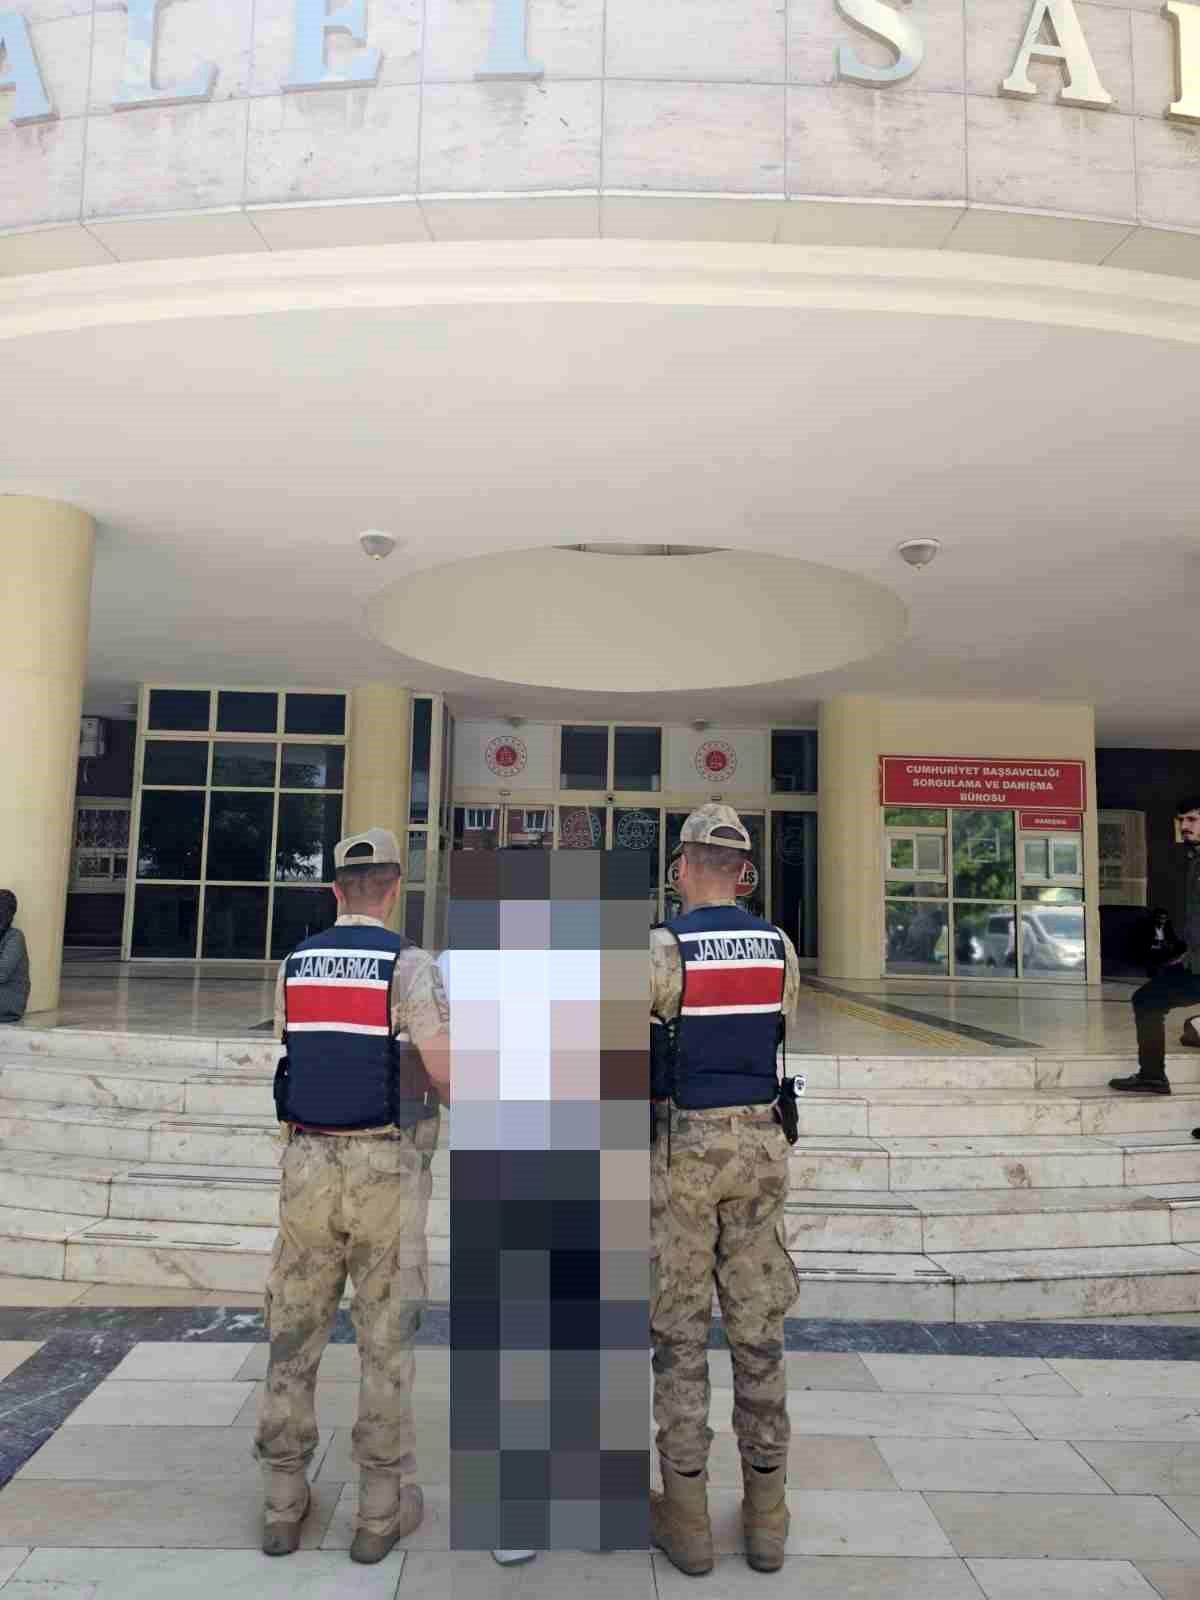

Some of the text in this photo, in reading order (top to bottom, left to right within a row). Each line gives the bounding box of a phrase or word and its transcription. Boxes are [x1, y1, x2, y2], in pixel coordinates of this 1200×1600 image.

[906, 764, 979, 776] CUMHURİYET
[912, 778, 1054, 792] SORGULAMA VE DANIŞMA
[694, 938, 777, 960] JANDARMA
[295, 956, 380, 980] JANDARMA
